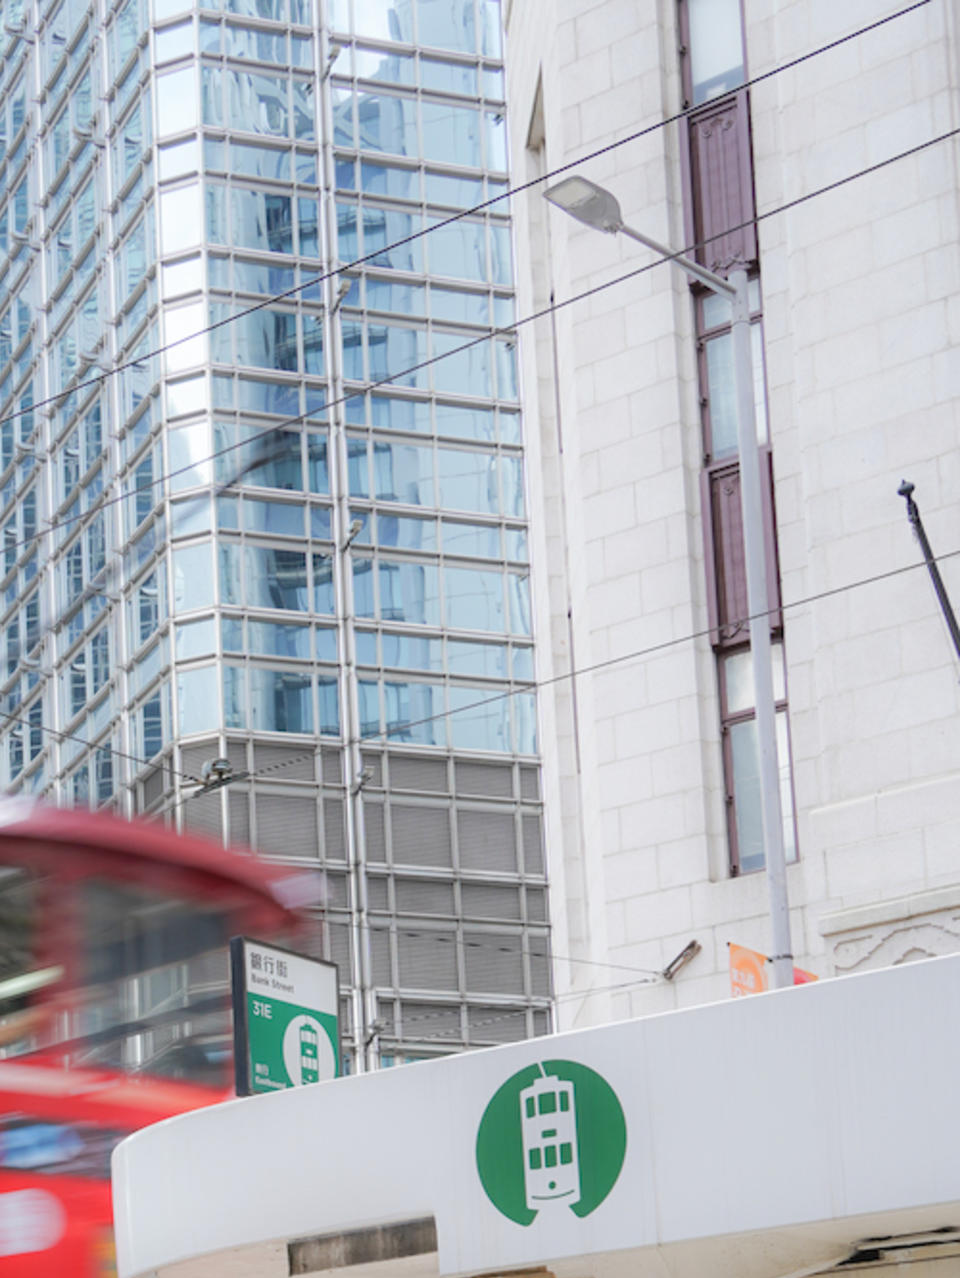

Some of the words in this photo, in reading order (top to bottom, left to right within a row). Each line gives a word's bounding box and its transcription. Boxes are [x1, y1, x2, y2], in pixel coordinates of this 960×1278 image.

[250, 951, 288, 978] 銀行街
[251, 973, 269, 986] Bank
[271, 978, 294, 993] Street
[252, 1000, 273, 1020] 31E
